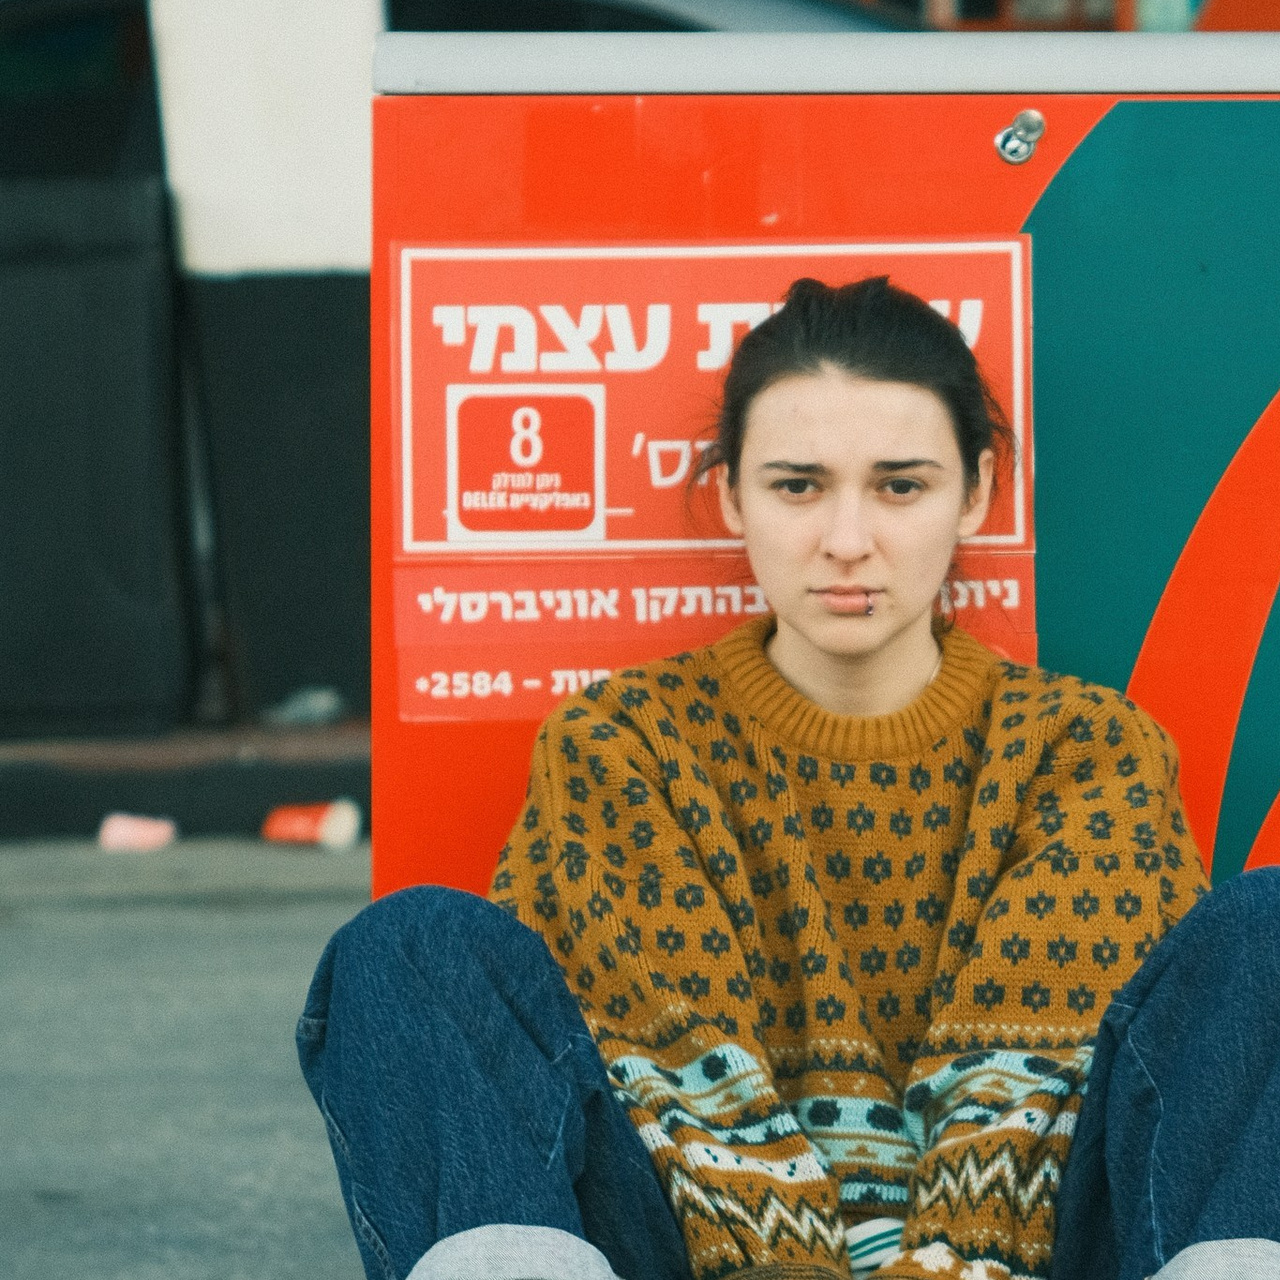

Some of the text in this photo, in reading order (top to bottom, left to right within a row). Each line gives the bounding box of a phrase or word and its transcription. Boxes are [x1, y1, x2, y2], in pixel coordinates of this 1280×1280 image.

[432, 303, 672, 372] עצמי
[510, 407, 543, 467] 8
[417, 586, 620, 623] אוניברסלי
